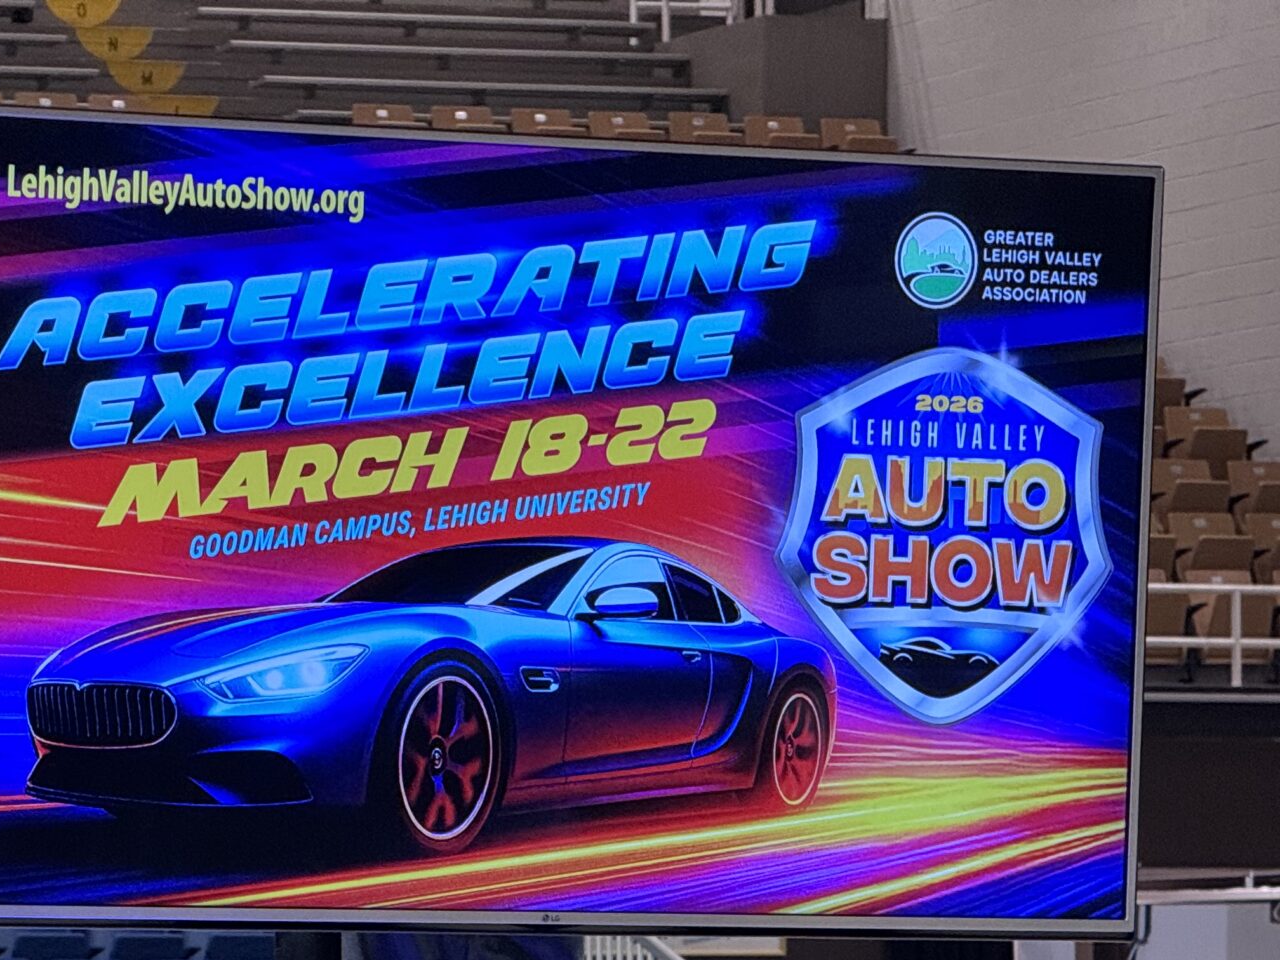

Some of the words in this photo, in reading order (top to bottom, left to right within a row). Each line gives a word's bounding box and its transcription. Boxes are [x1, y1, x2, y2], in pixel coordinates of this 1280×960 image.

[6, 163, 366, 223] LehighValleyAutoShow.org
[982, 248, 1040, 265] LEHIGH
[1045, 251, 1102, 267] VALLEY
[983, 229, 1054, 247] GREATER
[981, 286, 1087, 304] ASSOCIATION
[982, 268, 1025, 283] AUTO
[1029, 270, 1098, 287] DEALERS
[70, 310, 746, 450] EXCELLENCE
[914, 394, 984, 414] 2026
[851, 418, 938, 448] LEHIGH
[956, 422, 1045, 452] VALLEY
[96, 427, 470, 528] MARCH
[490, 398, 717, 481] 18-22
[820, 453, 1067, 531] AUTO
[189, 522, 308, 560] GOODMAN
[314, 510, 416, 545] CAMPUS,
[424, 499, 509, 532] LEHIGH
[515, 482, 651, 521] UNIVERSITY
[810, 530, 1073, 608] SHOW
